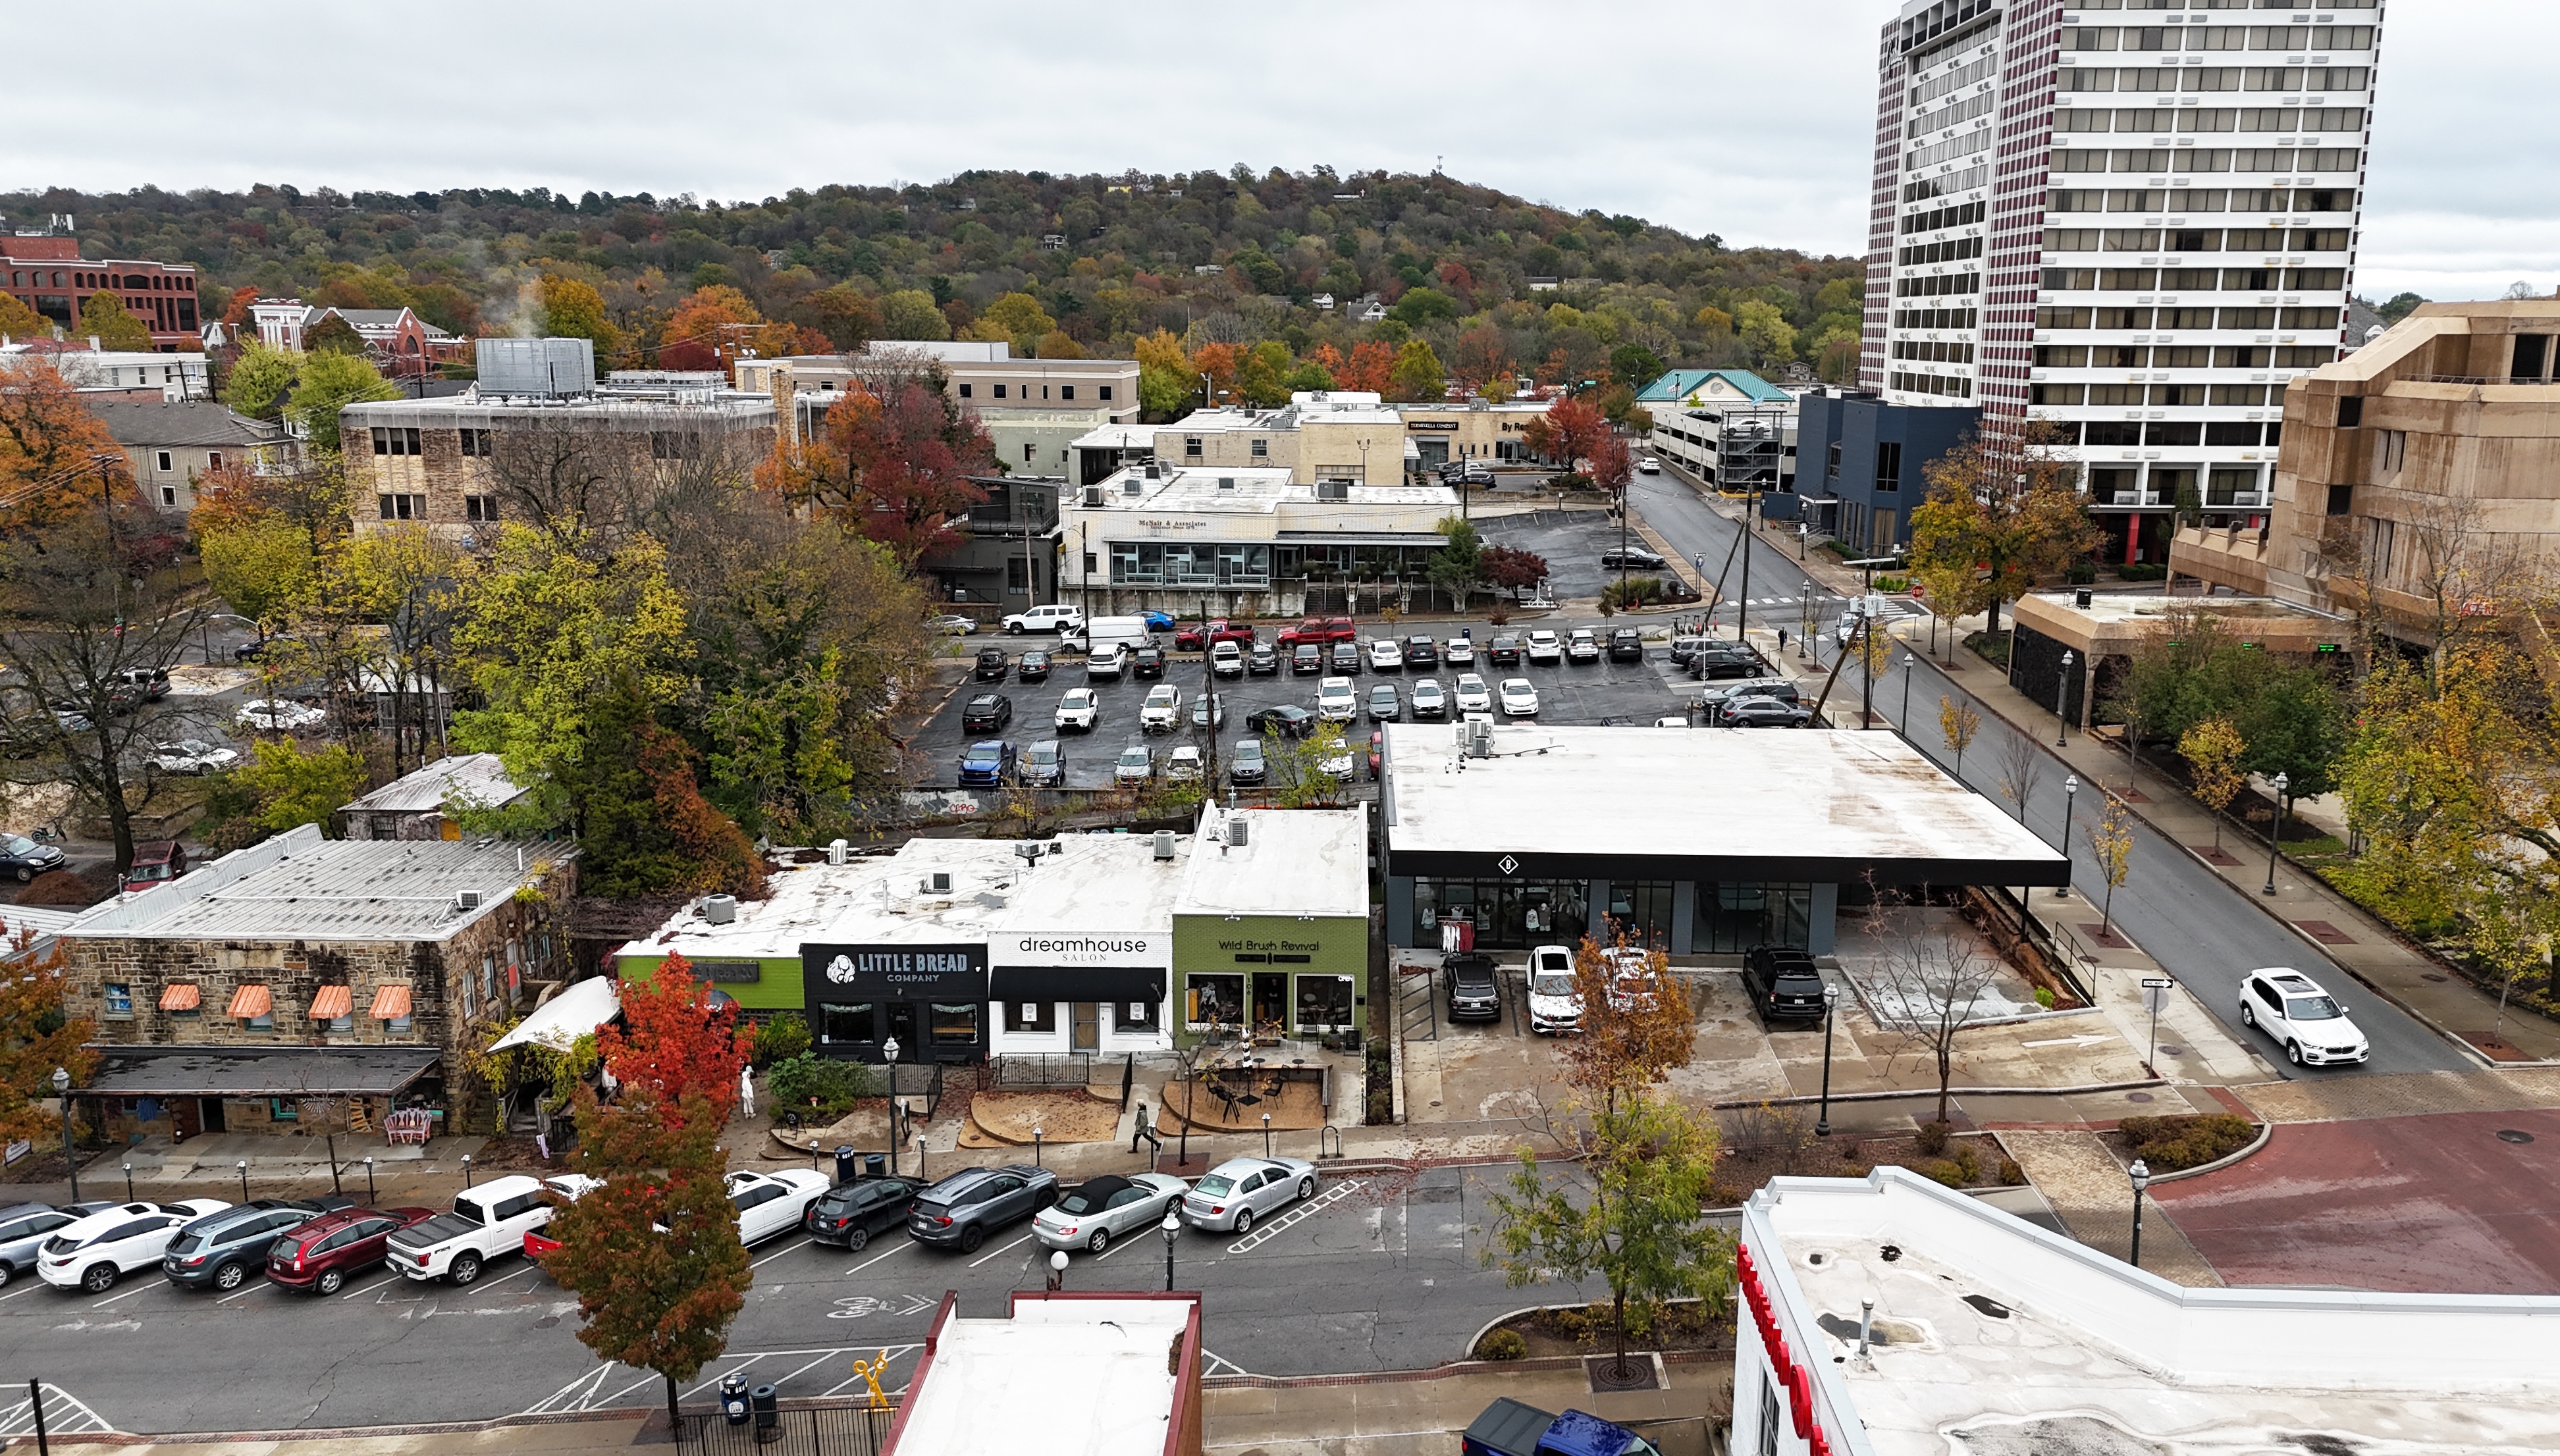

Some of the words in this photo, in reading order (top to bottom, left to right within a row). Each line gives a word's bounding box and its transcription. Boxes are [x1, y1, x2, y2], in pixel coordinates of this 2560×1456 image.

[1502, 423, 1512, 432] By
[1020, 937, 1146, 952] dreamhouse
[1219, 941, 1242, 950] Wild
[1246, 941, 1277, 950] Brush
[1281, 941, 1319, 950] Revival
[859, 954, 911, 972] LITTLE
[916, 954, 967, 972] BREAD
